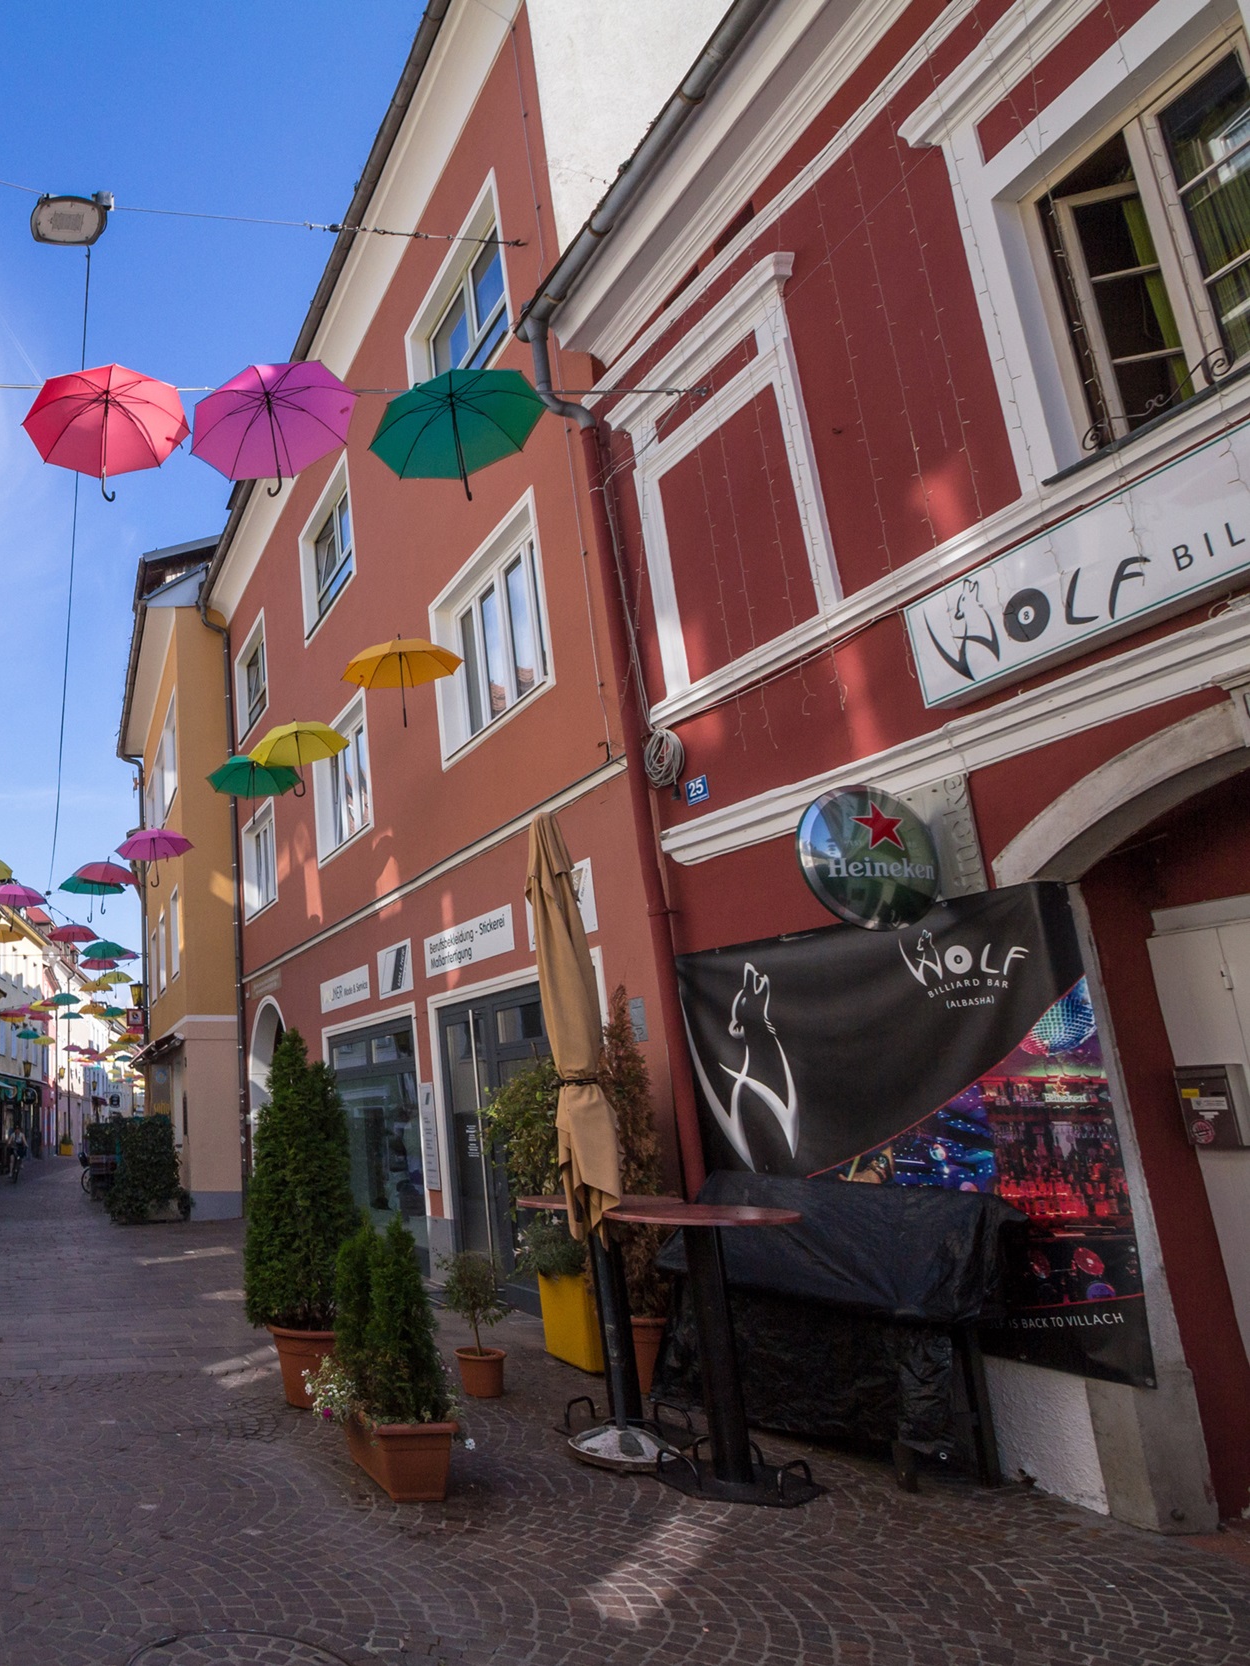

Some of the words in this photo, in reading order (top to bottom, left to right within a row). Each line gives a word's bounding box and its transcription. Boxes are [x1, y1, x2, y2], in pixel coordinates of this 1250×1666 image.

[922, 556, 1151, 681] WOLF
[688, 779, 704, 798] 25
[828, 857, 935, 880] Heineken
[430, 929, 474, 954] Berufsbekleidung
[479, 914, 505, 935] Stickerei
[431, 947, 472, 969] Maßanfertigung
[898, 938, 1030, 986] WOLF
[927, 979, 980, 998] BILLIARD
[987, 979, 1009, 989] BAR
[946, 995, 995, 1009] (ALBASHA)
[1008, 1319, 1018, 1329] IS
[1022, 1317, 1049, 1329] BACK
[1050, 1316, 1064, 1328] TO
[1065, 1312, 1125, 1327] VILLACH
